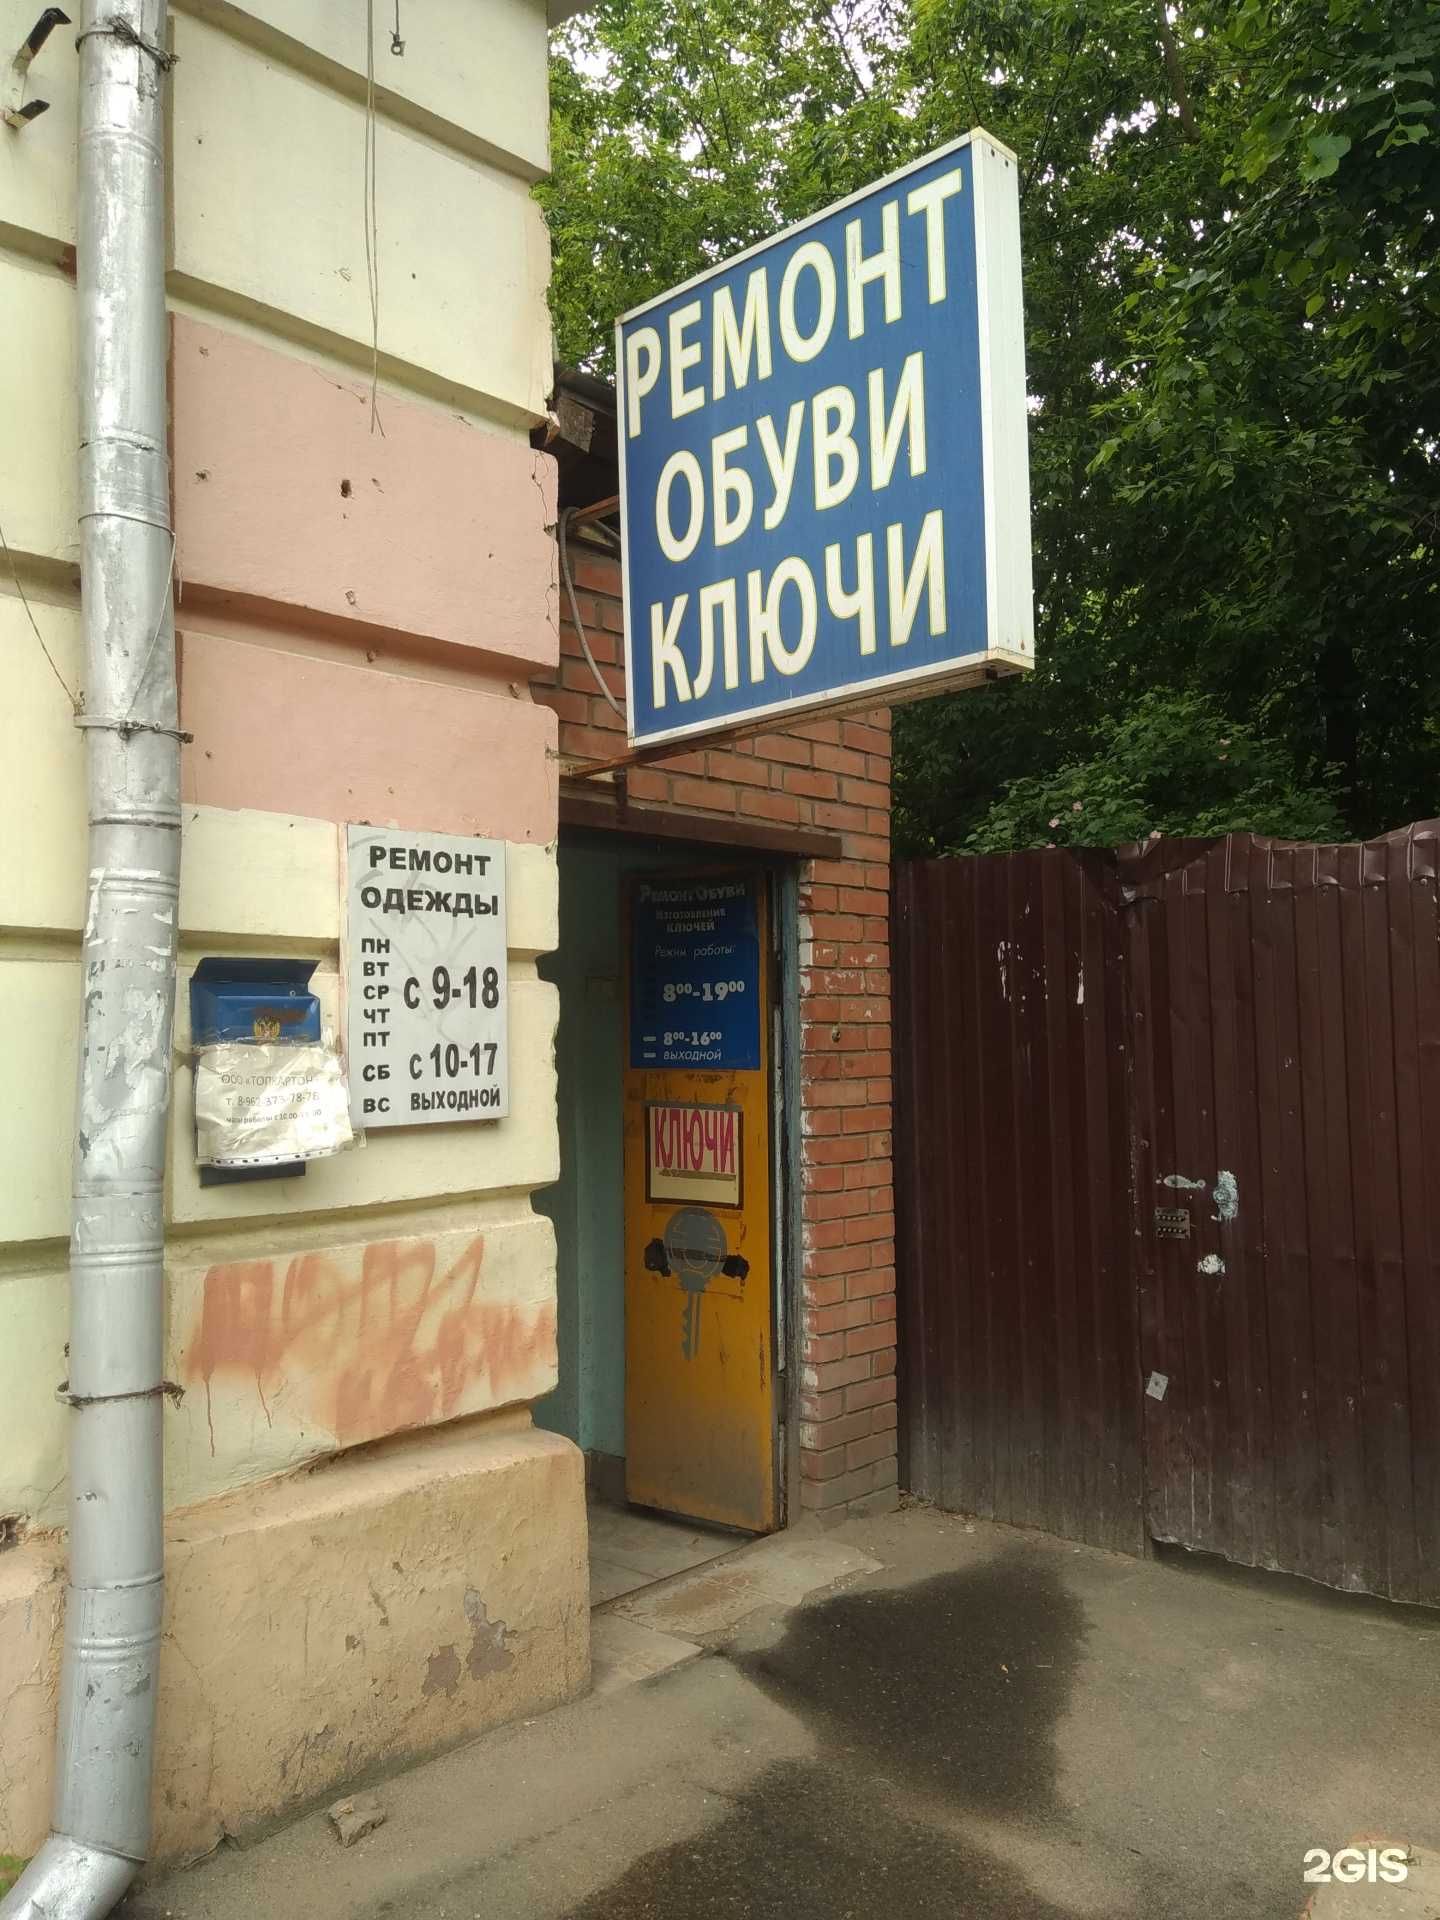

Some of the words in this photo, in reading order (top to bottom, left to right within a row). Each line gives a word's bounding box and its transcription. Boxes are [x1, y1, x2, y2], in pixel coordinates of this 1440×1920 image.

[626, 166, 963, 440] РЕМОНТ
[655, 350, 928, 563] ОБУВИ
[650, 508, 947, 709] КЛЮЧИ
[369, 845, 491, 877] РЕМОНТ
[360, 886, 499, 919] ОДЕЖДЫ
[361, 937, 391, 954] ПН
[363, 961, 390, 977] ВТ
[363, 984, 390, 1000] СР
[431, 965, 500, 1010] 9-18
[363, 1008, 391, 1024] ЧТ
[363, 1031, 391, 1047] ПТ
[362, 1064, 391, 1083] СБ
[429, 1042, 499, 1079] 10-17
[363, 1097, 391, 1114] ВС
[654, 1108, 736, 1174] КЛЮЧИ
